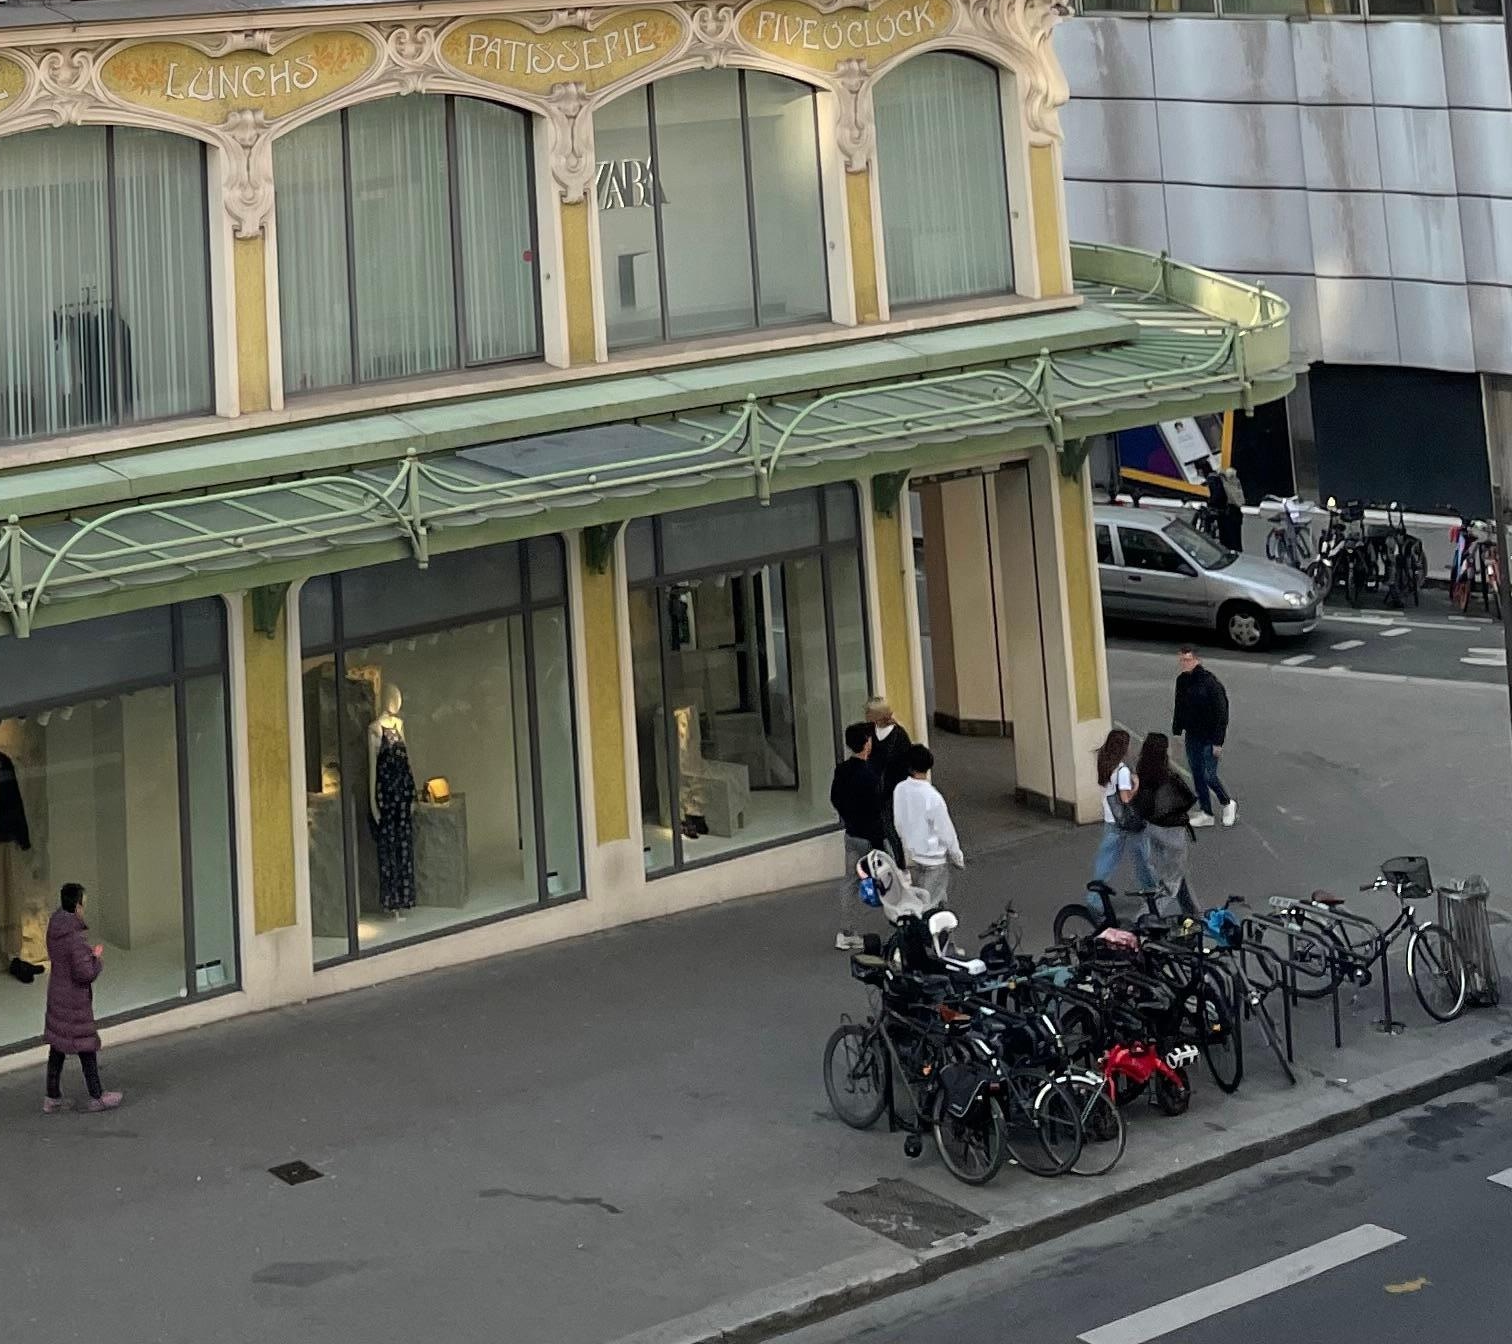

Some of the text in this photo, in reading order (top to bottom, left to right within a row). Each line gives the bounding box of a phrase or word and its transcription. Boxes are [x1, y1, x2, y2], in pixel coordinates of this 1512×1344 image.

[467, 21, 657, 75] PATISSERIE
[756, 0, 936, 50] FIVE O'CLOCK
[165, 54, 319, 102] LUNCHS
